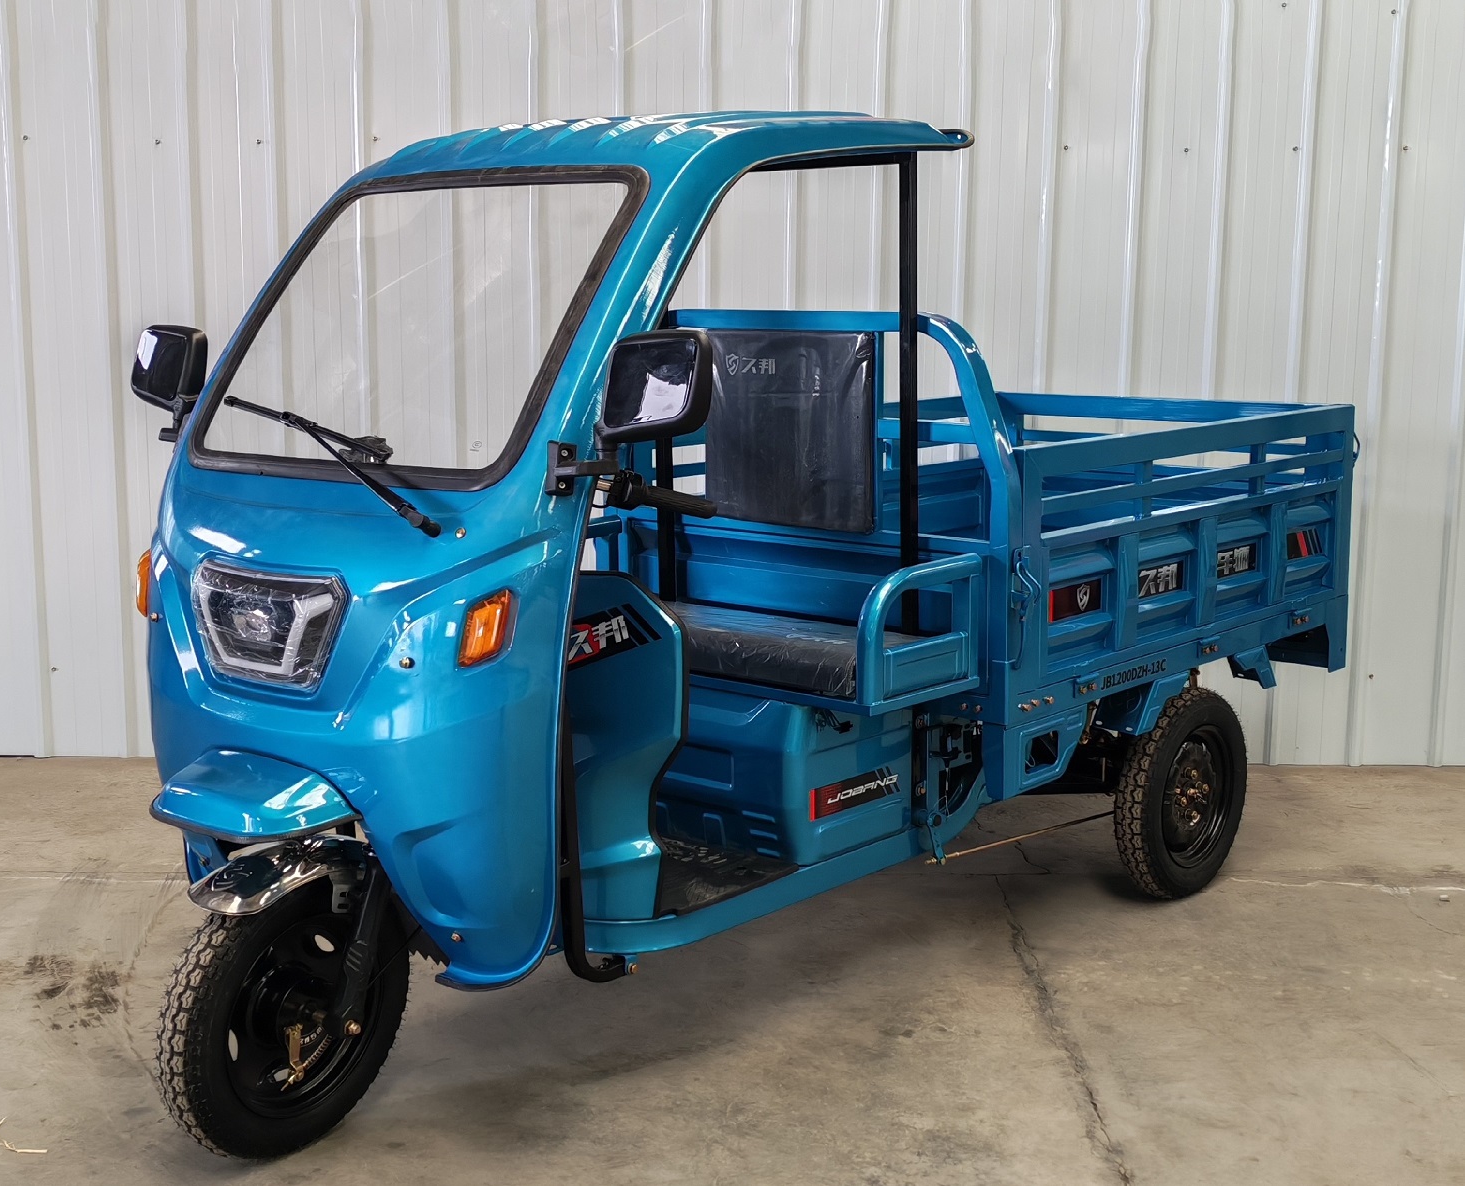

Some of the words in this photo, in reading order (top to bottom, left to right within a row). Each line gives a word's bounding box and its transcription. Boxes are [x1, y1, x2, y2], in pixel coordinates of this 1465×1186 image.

[741, 357, 776, 375] 久邦
[1138, 563, 1178, 598] 久邦
[568, 615, 630, 661] 久邦
[1100, 658, 1167, 691] JB1200DZH-13C
[826, 774, 899, 805] JOBANG
